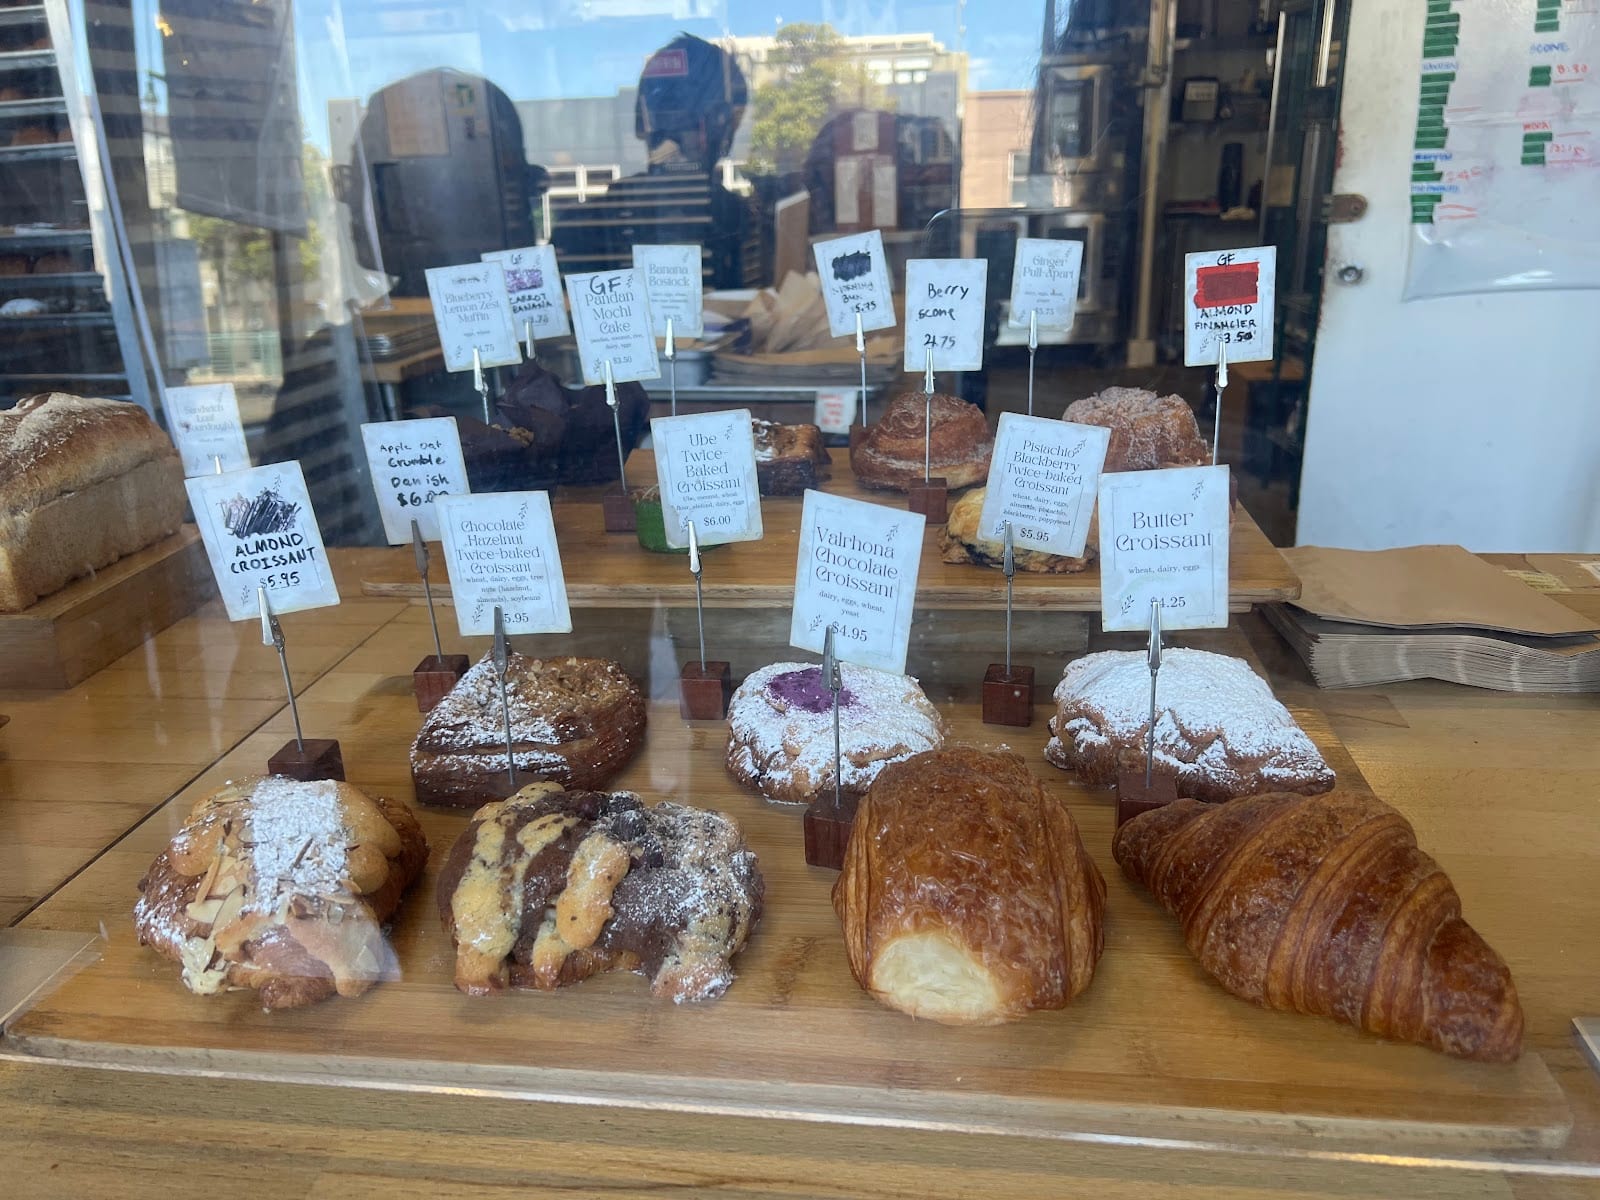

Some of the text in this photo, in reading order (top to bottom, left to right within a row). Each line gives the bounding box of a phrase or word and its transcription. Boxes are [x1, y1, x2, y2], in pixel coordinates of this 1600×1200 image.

[1032, 256, 1066, 269] Ginger
[1217, 253, 1236, 266] GF
[648, 264, 689, 275] Banana
[1022, 267, 1075, 281] Pull-Apart
[589, 275, 622, 296] GF
[648, 276, 690, 287] Bostock
[445, 290, 493, 304] Blueberry
[510, 293, 546, 304] CARROT
[585, 291, 634, 307] Pandan
[928, 283, 969, 300] Berry
[443, 300, 500, 315] Lemon Zest
[513, 301, 552, 314] BANANA
[592, 305, 632, 321] Mochi
[1200, 304, 1253, 318] ALMOND
[458, 311, 490, 322] Muffin
[599, 322, 631, 335] Cake
[1194, 319, 1257, 330] FINANCIER
[689, 433, 717, 446] Ube
[380, 442, 412, 455] Apple
[681, 449, 729, 462] Twice-
[1022, 439, 1076, 458] Pistachio
[388, 453, 446, 468] Crumble
[1013, 451, 1080, 475] Blackberry
[685, 461, 729, 477] Baked
[1007, 462, 1082, 485] Twice-baked
[390, 473, 450, 488] Danish
[677, 478, 740, 494] Croissant
[1014, 476, 1069, 496] Croissant
[460, 519, 525, 533] Chocolate
[703, 515, 731, 527] $6.00
[1132, 511, 1194, 529] Butter
[467, 534, 524, 547] Hazelnut
[1020, 527, 1049, 542] $5.95
[1115, 530, 1211, 552] Croissant
[235, 533, 304, 558] ALMOND
[816, 526, 895, 559] Valrhona
[230, 547, 316, 574] CROISSANT
[456, 546, 541, 561] Twice-baked
[470, 562, 531, 575] Croissant
[815, 545, 898, 580] Chocolate
[1128, 564, 1200, 575] wheat, dairy, eggs
[260, 571, 301, 588] $5.95
[815, 565, 894, 599] Croissant
[819, 590, 840, 602] dairy,
[861, 602, 885, 614] wheat,
[503, 612, 529, 624] 5.95
[832, 620, 867, 642] $4.95
